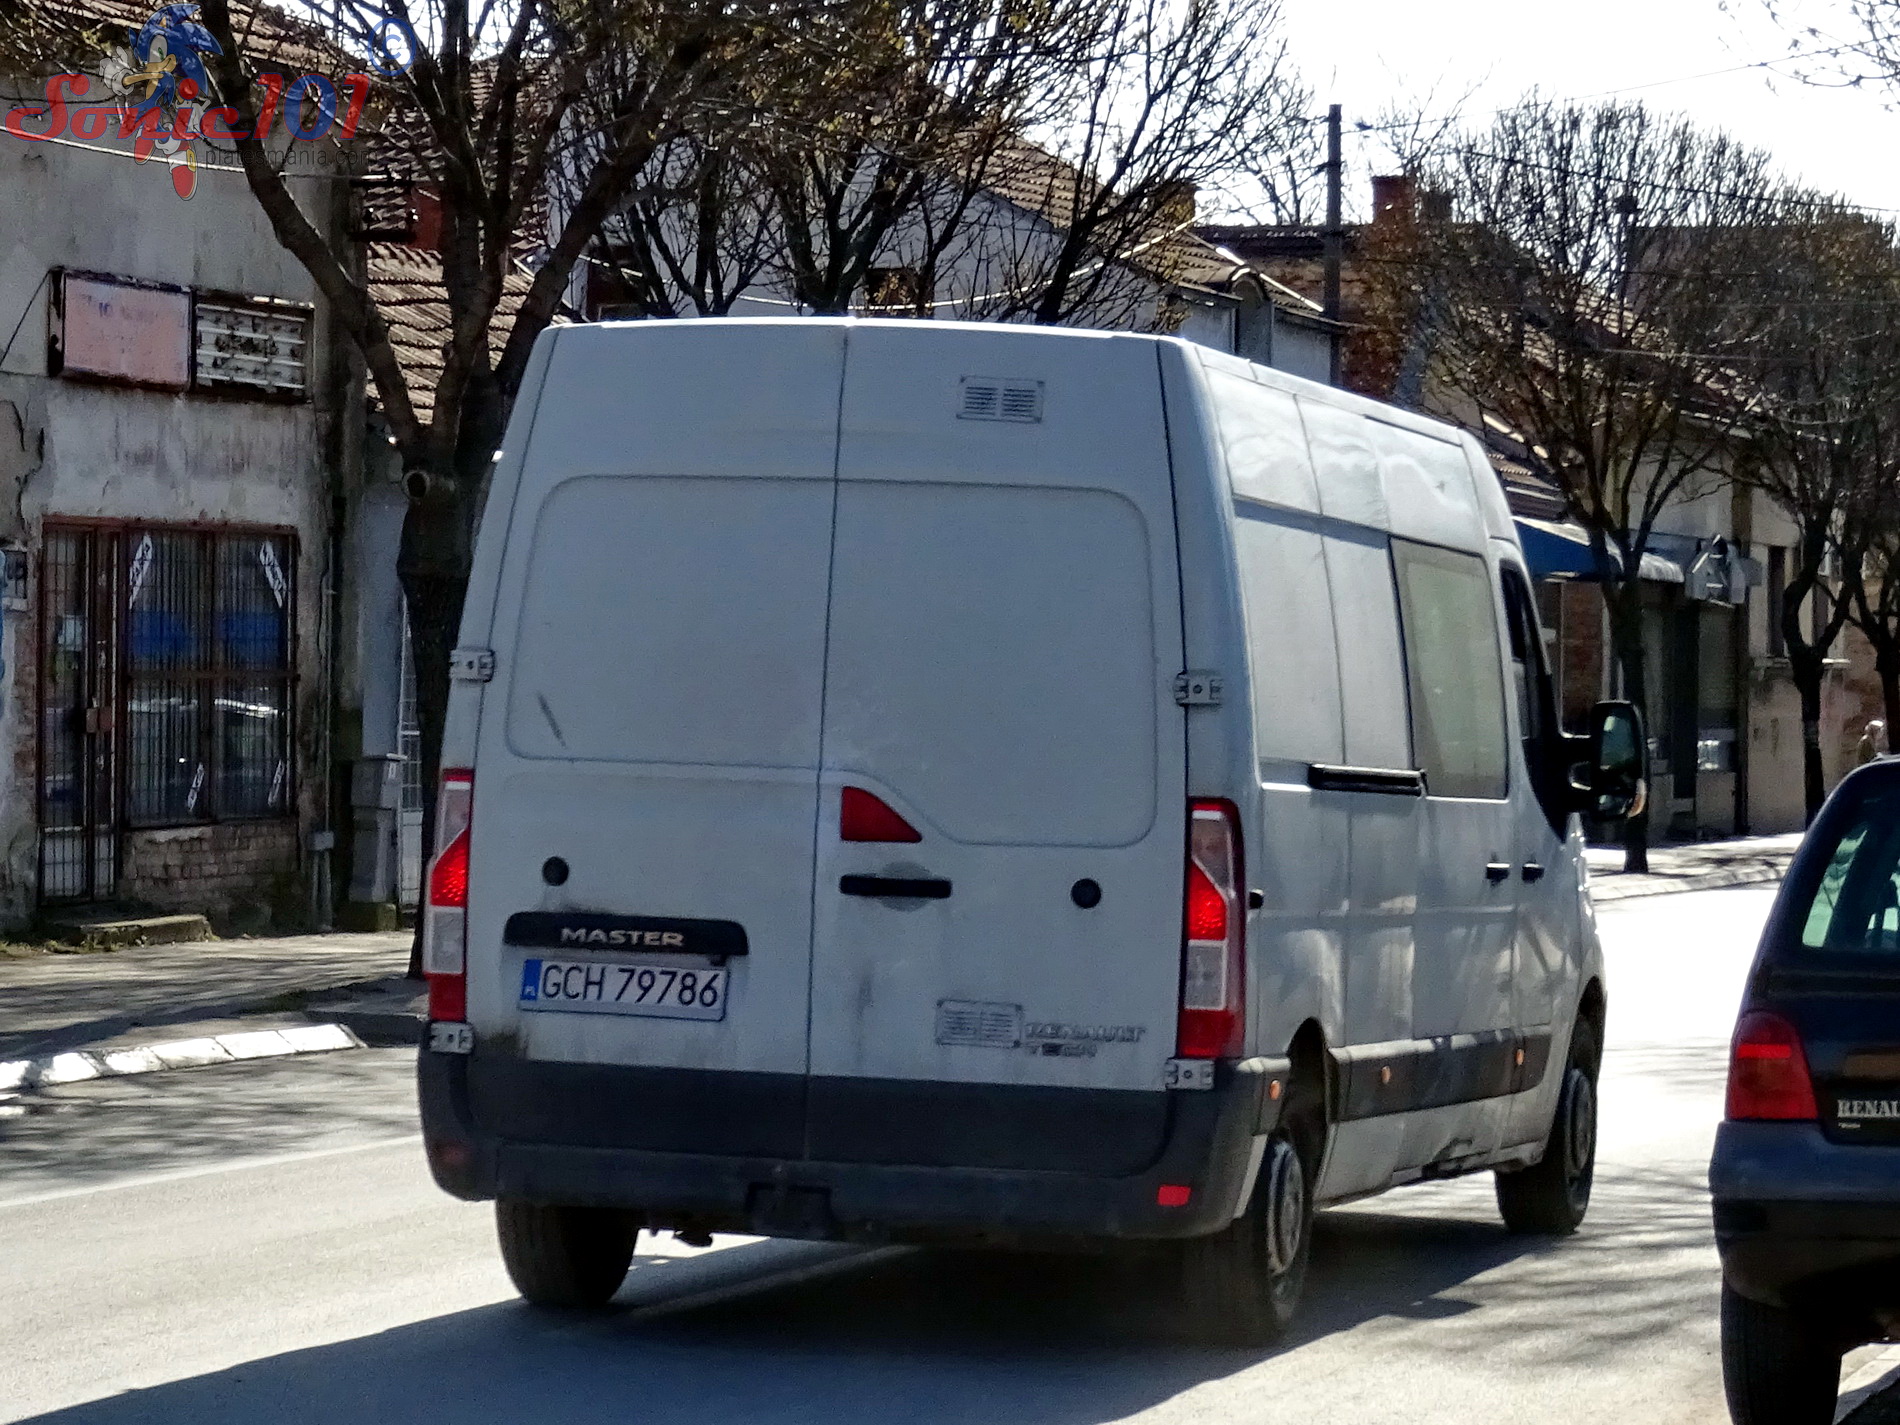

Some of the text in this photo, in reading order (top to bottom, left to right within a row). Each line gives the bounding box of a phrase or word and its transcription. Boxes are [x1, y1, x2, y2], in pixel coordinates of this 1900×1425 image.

[560, 927, 685, 947] MASTER
[542, 964, 721, 1008] GCH 79786
